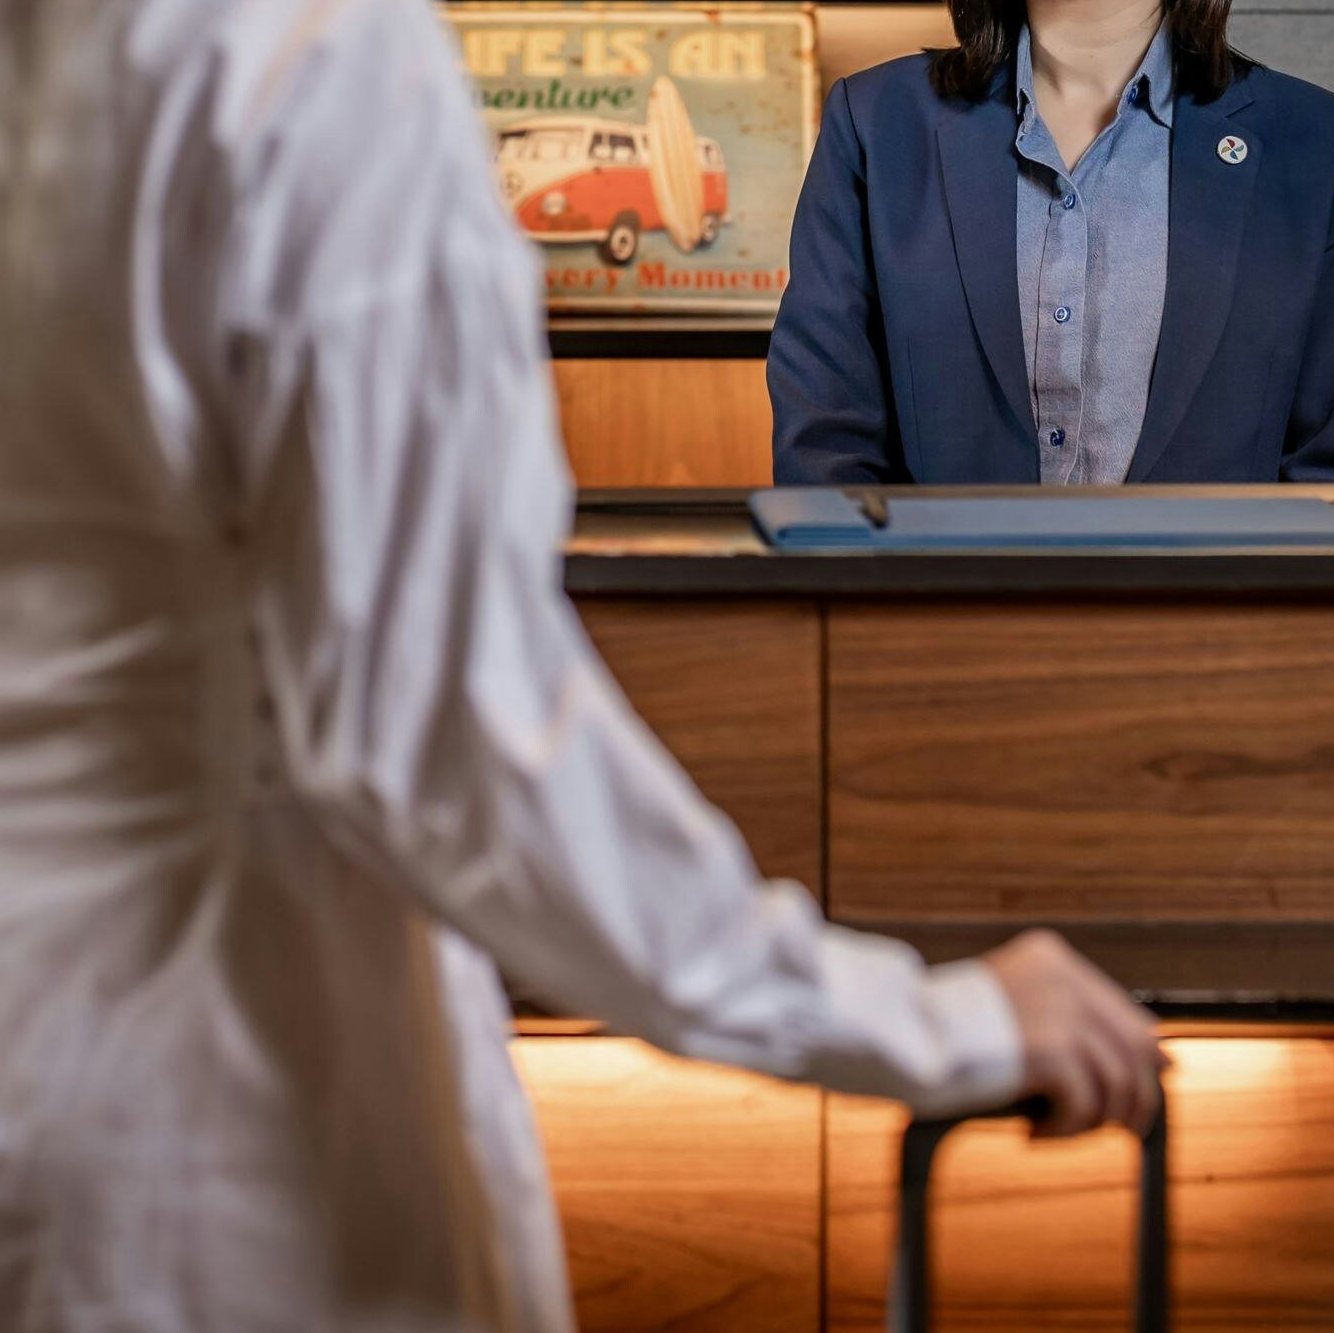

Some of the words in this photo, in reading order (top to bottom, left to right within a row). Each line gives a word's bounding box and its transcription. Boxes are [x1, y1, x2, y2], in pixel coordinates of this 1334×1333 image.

[464, 29, 567, 77] IFE
[581, 29, 652, 77] IS
[668, 30, 766, 78] AN
[544, 266, 626, 294] very
